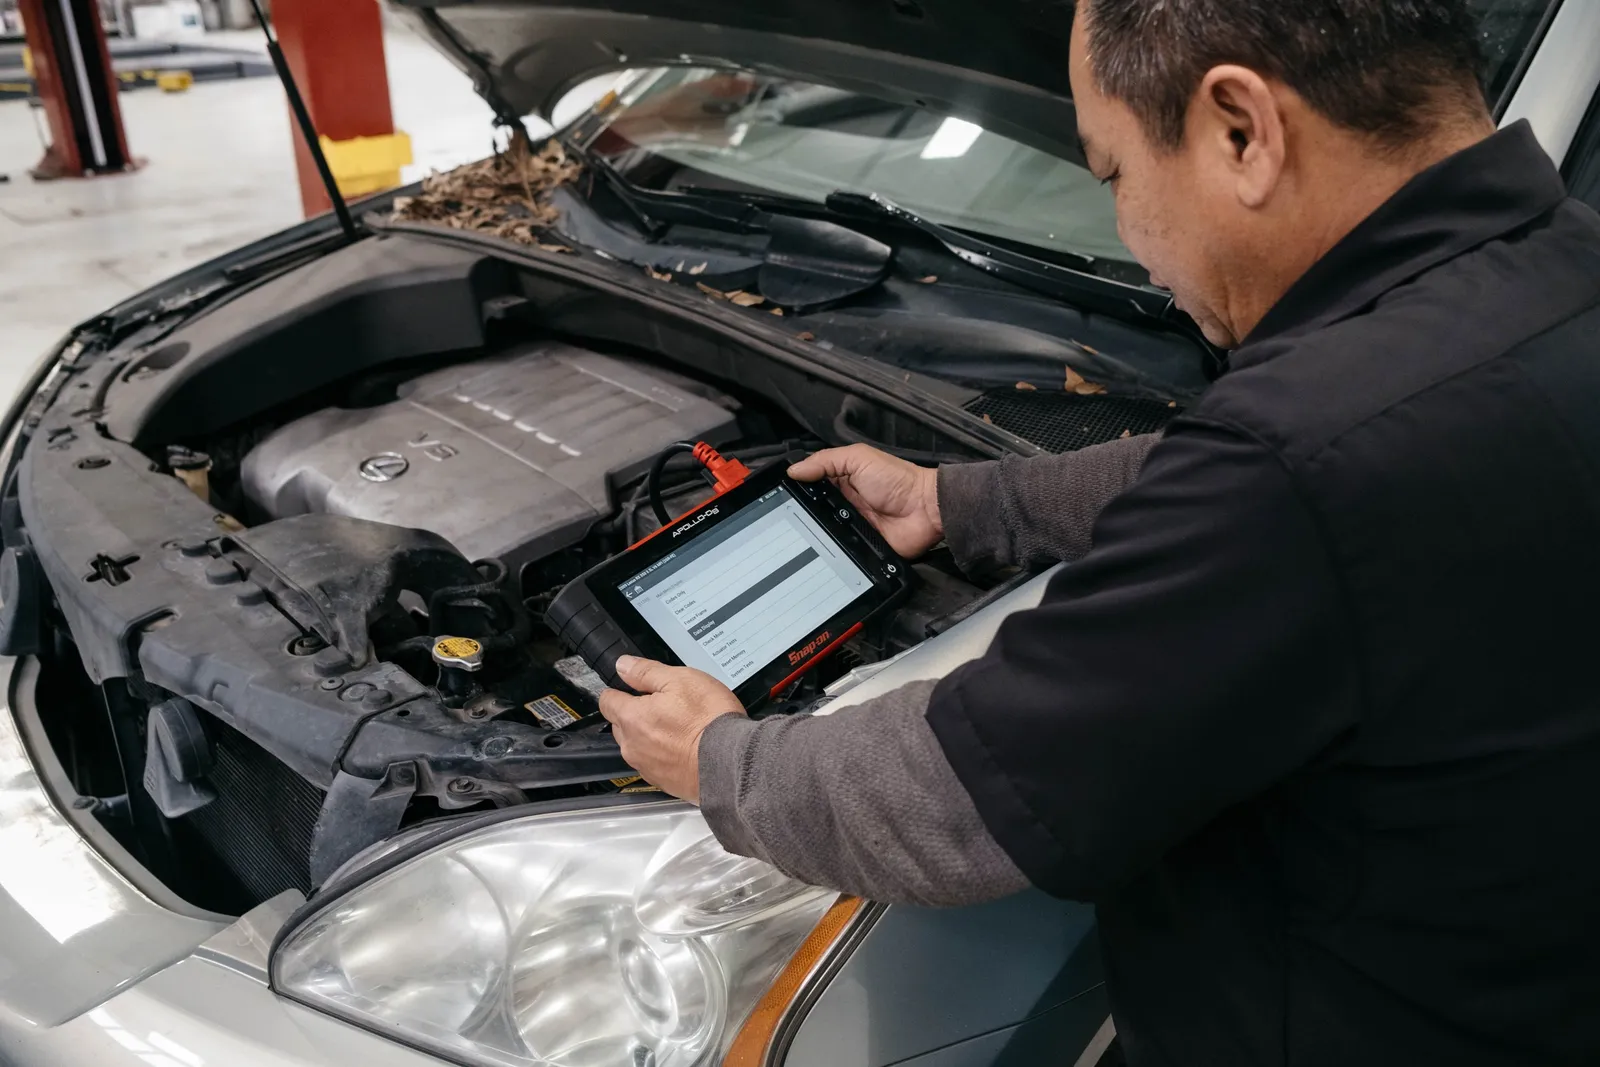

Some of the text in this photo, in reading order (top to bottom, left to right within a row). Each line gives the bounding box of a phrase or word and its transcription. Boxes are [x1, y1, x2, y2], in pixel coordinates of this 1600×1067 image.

[665, 590, 687, 605] Codes Only
[674, 600, 696, 615] Clear Codes
[684, 609, 708, 625] Freeze Frame
[693, 620, 716, 636] Data Display
[702, 630, 725, 646] Check Mode
[712, 638, 738, 657] Actuator Tests
[788, 631, 830, 665] Snap-on
[721, 649, 747, 667] Reset Memory
[731, 660, 754, 678] System Tests
